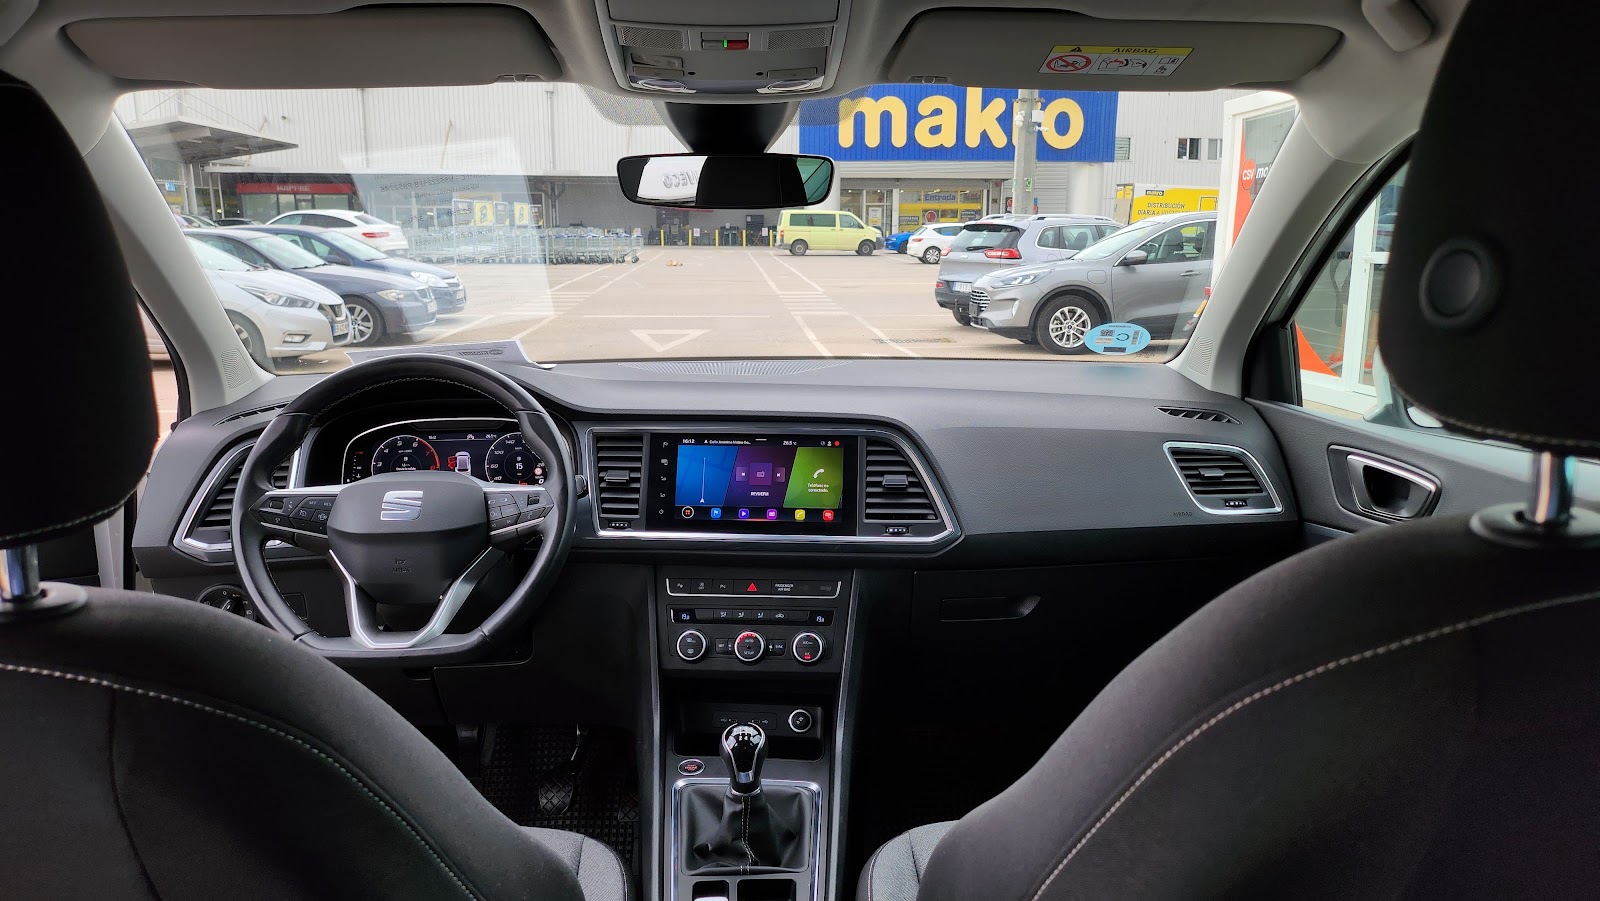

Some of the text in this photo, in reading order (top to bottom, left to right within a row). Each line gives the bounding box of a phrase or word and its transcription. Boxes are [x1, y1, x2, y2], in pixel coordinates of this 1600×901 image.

[838, 87, 1084, 149] mako
[1256, 164, 1272, 179] mo
[925, 192, 956, 201] Entrada
[516, 462, 523, 470] 15
